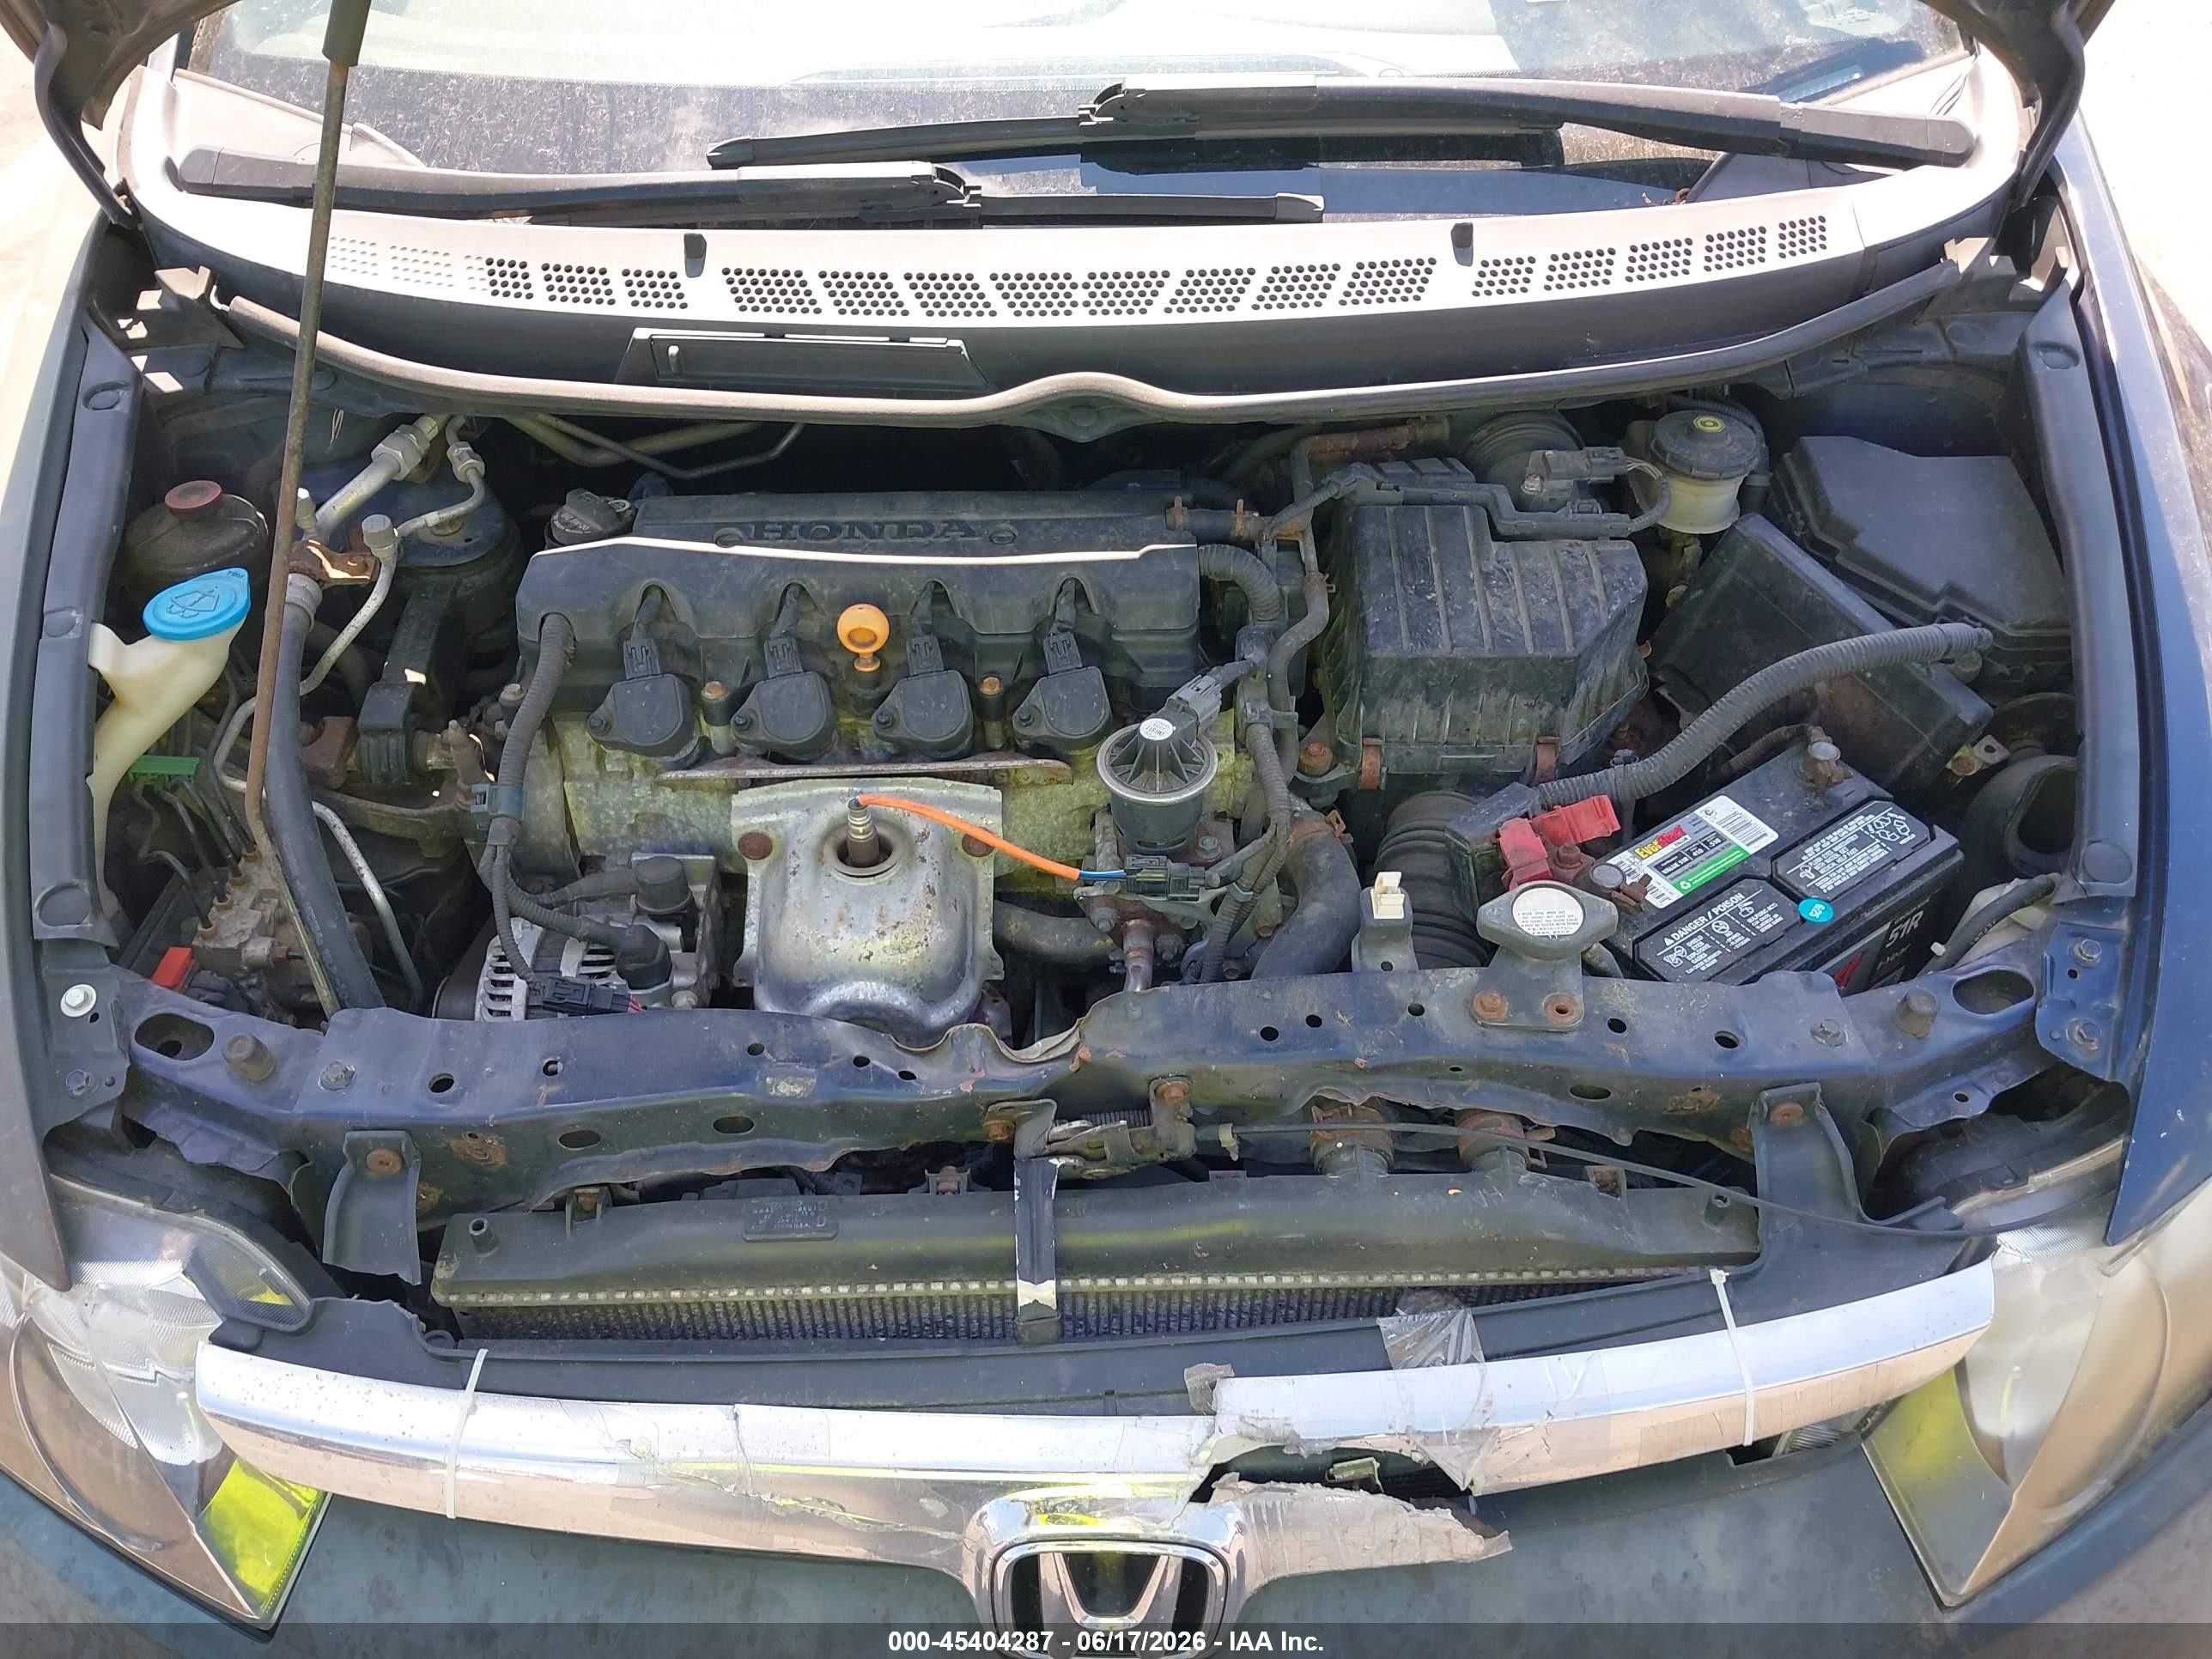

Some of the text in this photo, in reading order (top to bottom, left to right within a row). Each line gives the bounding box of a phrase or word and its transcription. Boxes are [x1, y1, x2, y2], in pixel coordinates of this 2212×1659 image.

[750, 520, 982, 543] HONDA
[1671, 916, 1708, 940] DANGER
[1712, 893, 1744, 914] POISON
[1886, 910, 1923, 948] 51R
